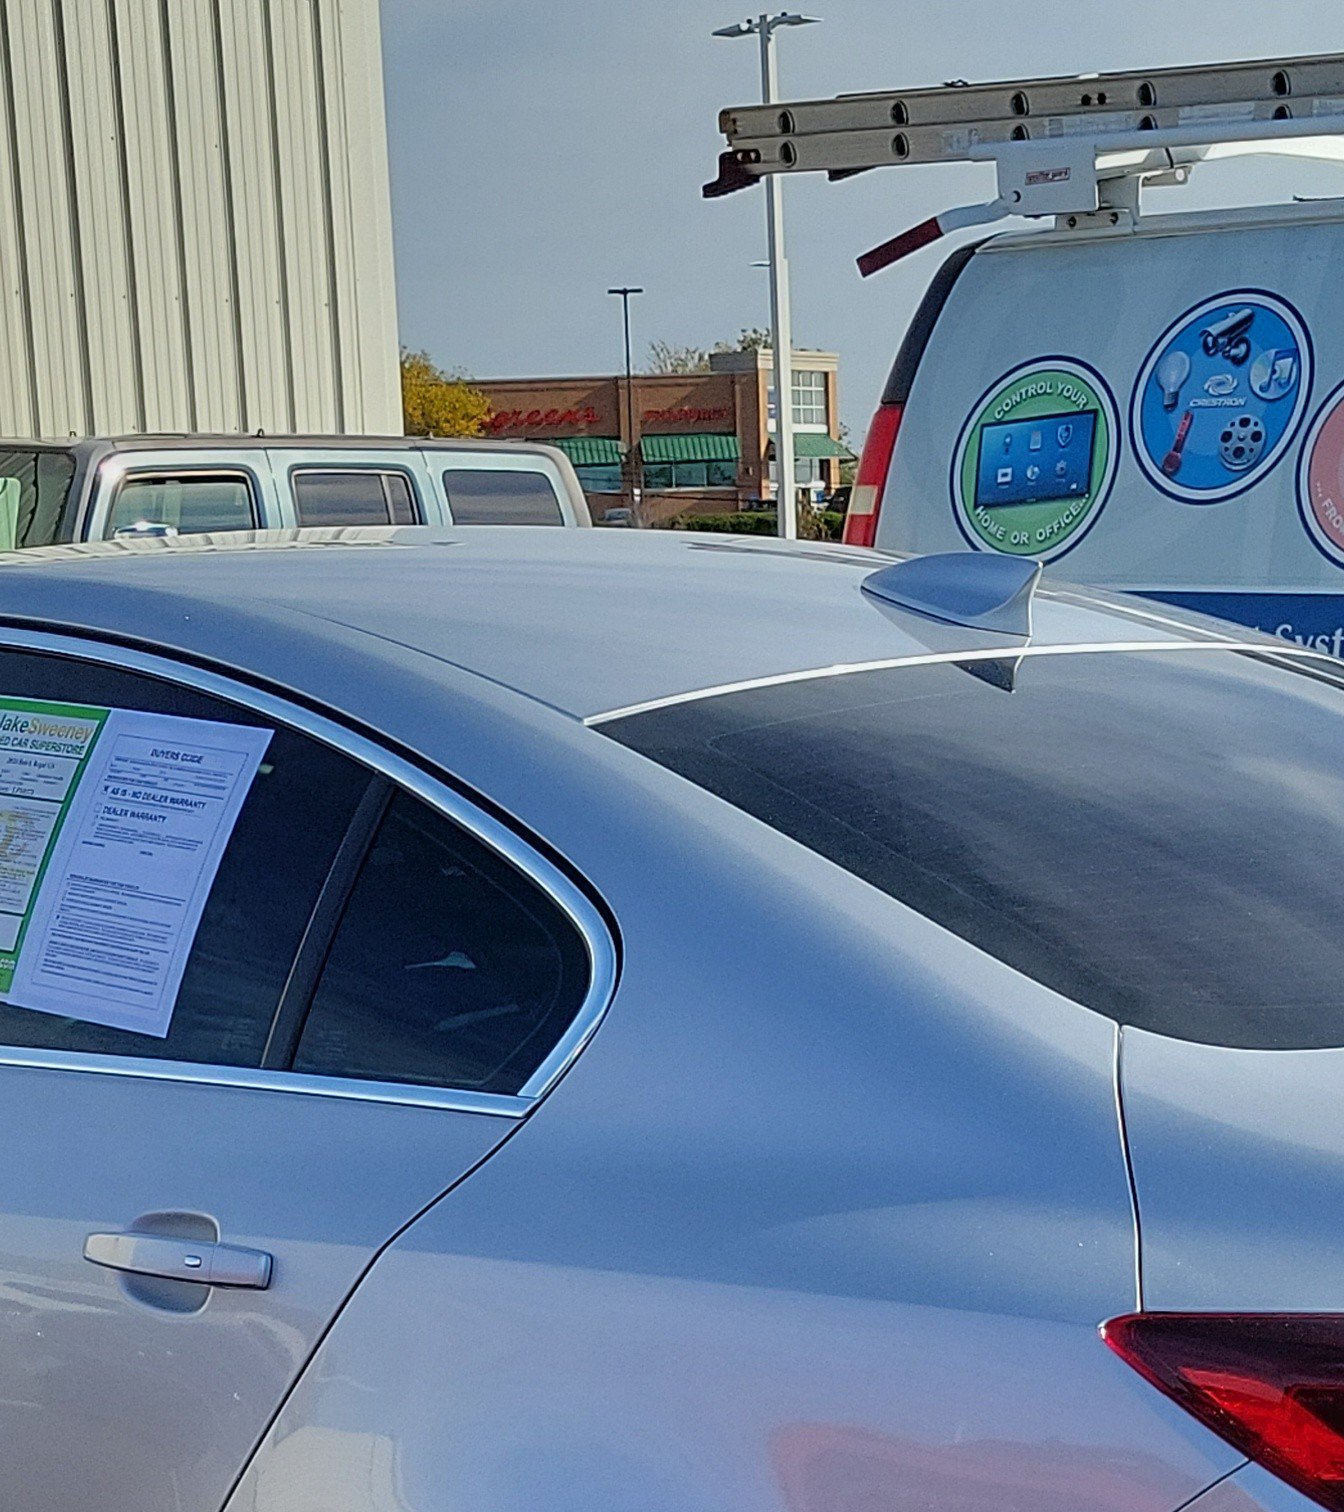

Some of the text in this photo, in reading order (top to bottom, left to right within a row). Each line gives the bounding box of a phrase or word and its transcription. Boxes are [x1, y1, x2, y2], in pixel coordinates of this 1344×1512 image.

[993, 381, 1089, 420] CONTROL YOUR
[975, 505, 1007, 541] HOME
[1010, 529, 1030, 545] OR
[11, 736, 29, 748] CAR
[29, 739, 85, 755] SUPERSTORE
[102, 806, 167, 823] DEALER WARRANTY
